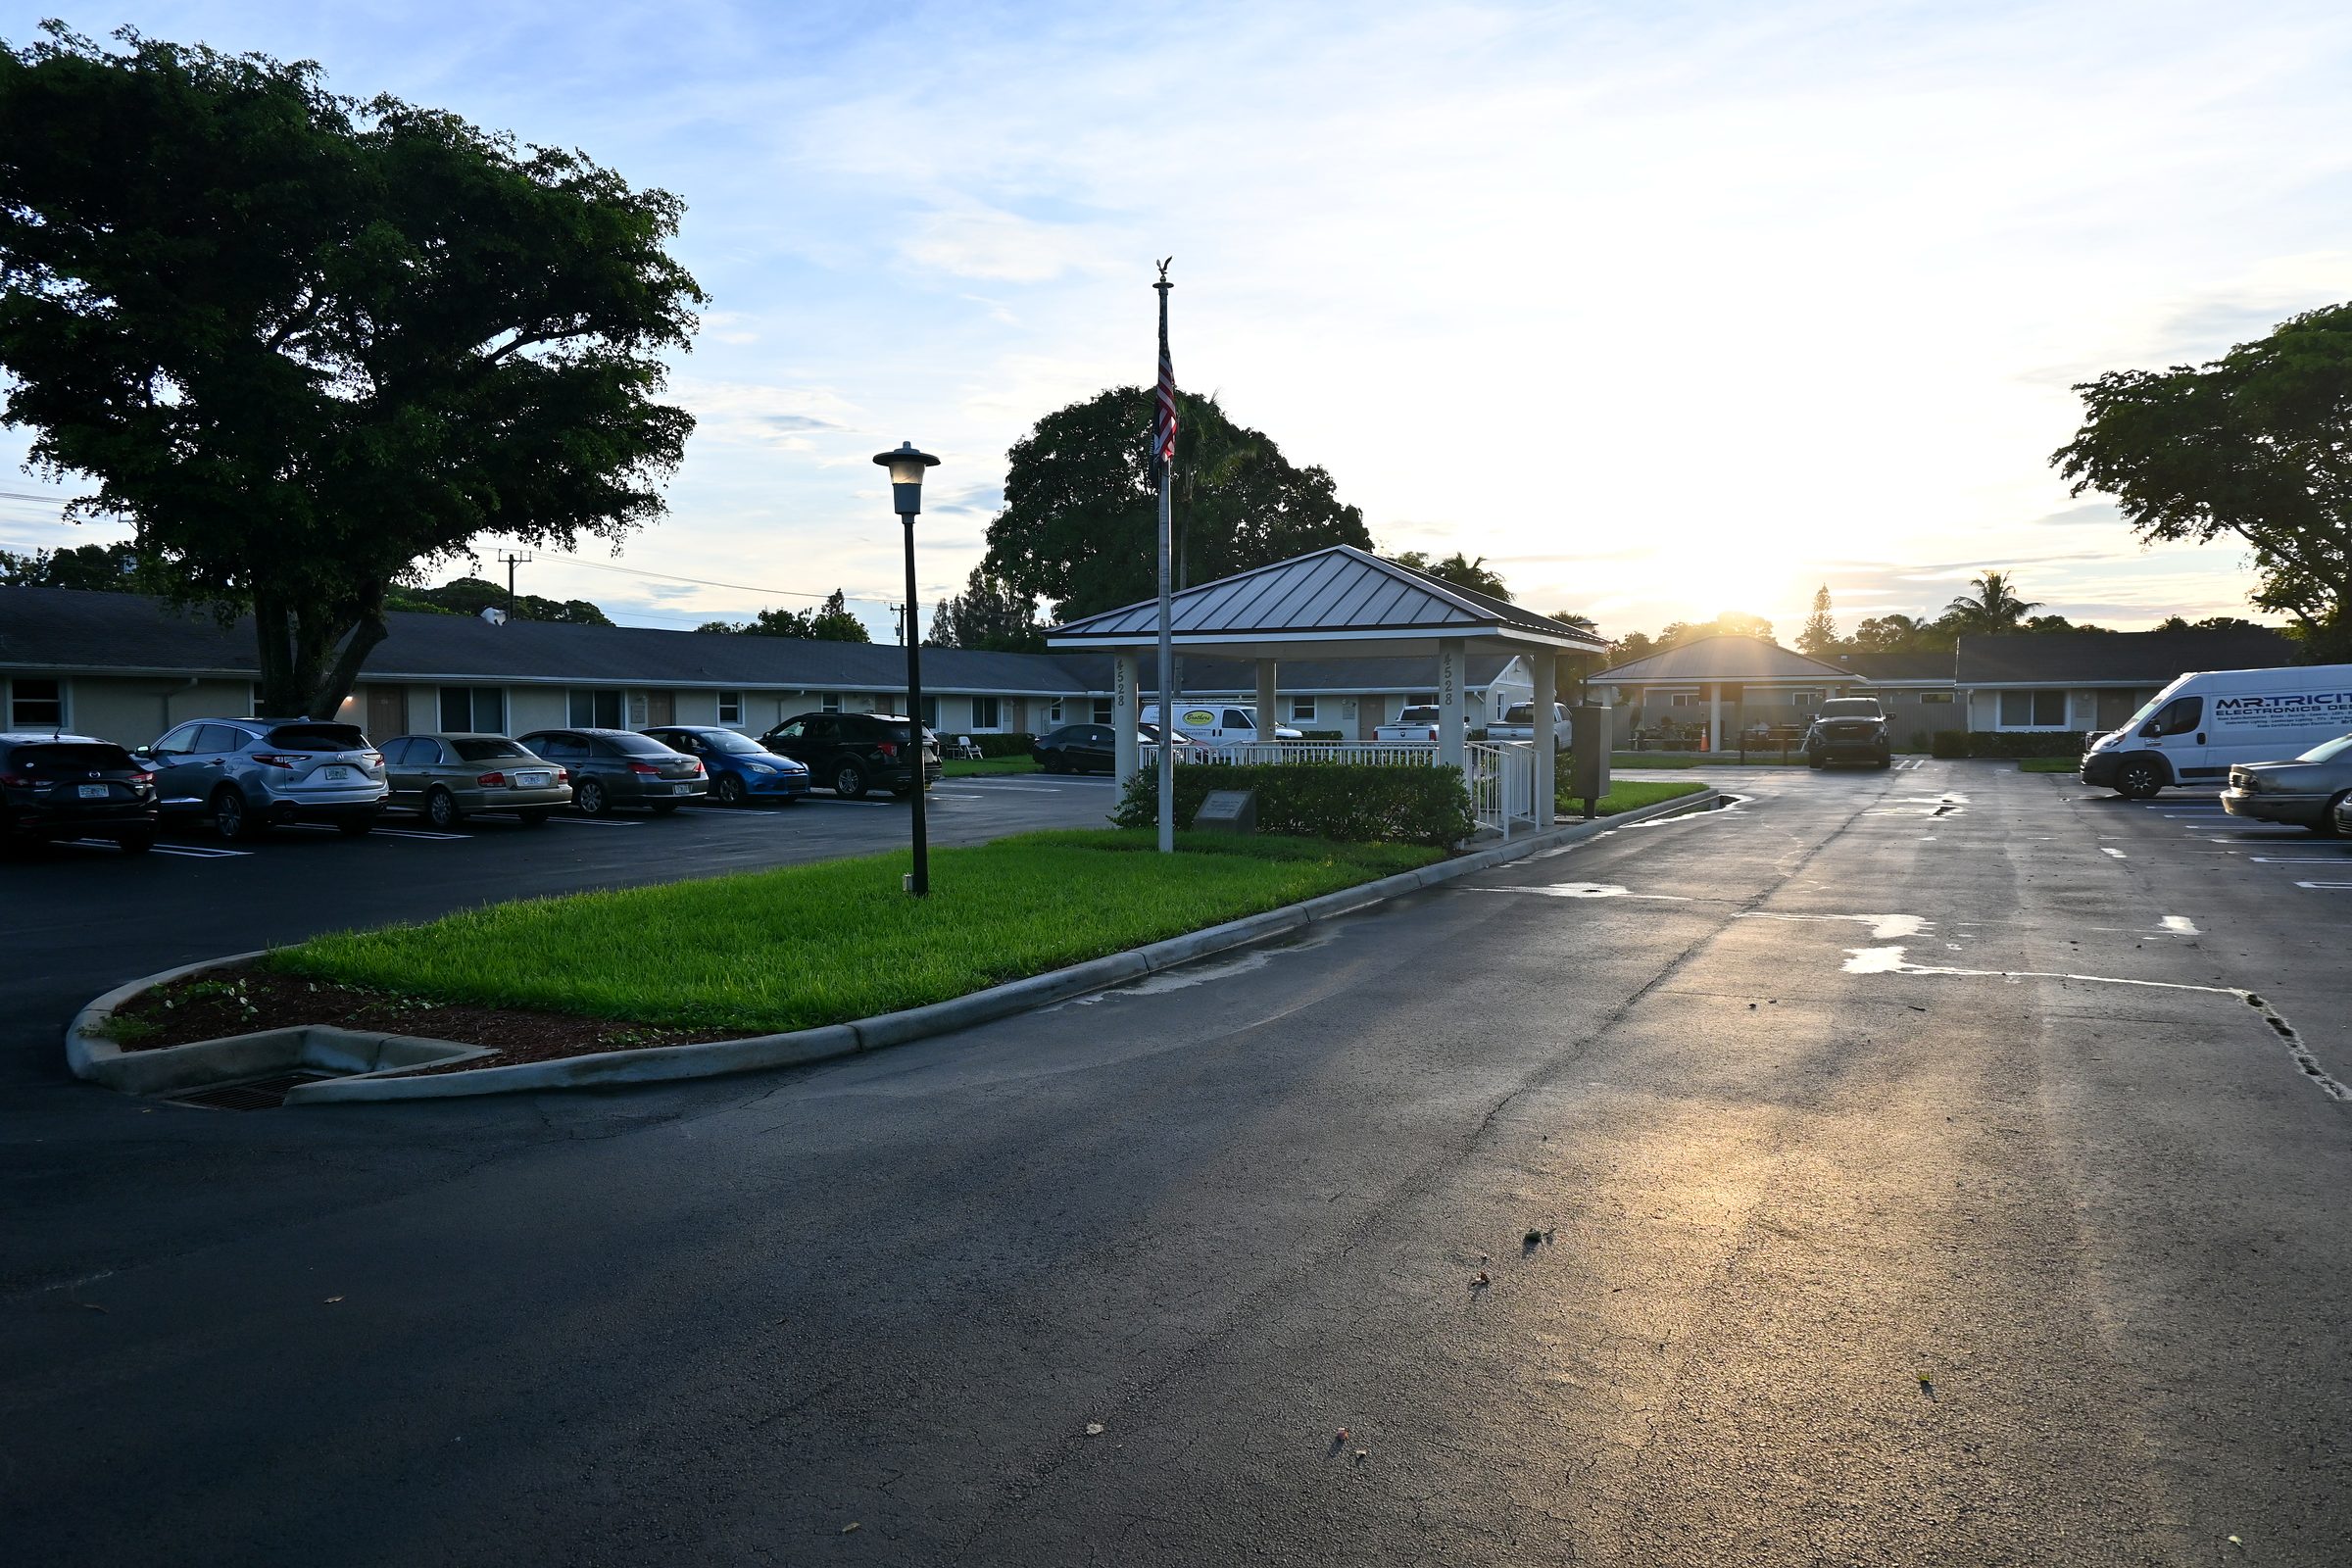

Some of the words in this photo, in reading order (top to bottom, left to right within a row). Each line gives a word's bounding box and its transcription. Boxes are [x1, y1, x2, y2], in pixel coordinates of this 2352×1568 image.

[1116, 658, 1125, 707] 4528
[1444, 653, 1452, 706] 4528
[2216, 706, 2322, 716] ELECTRONICS
